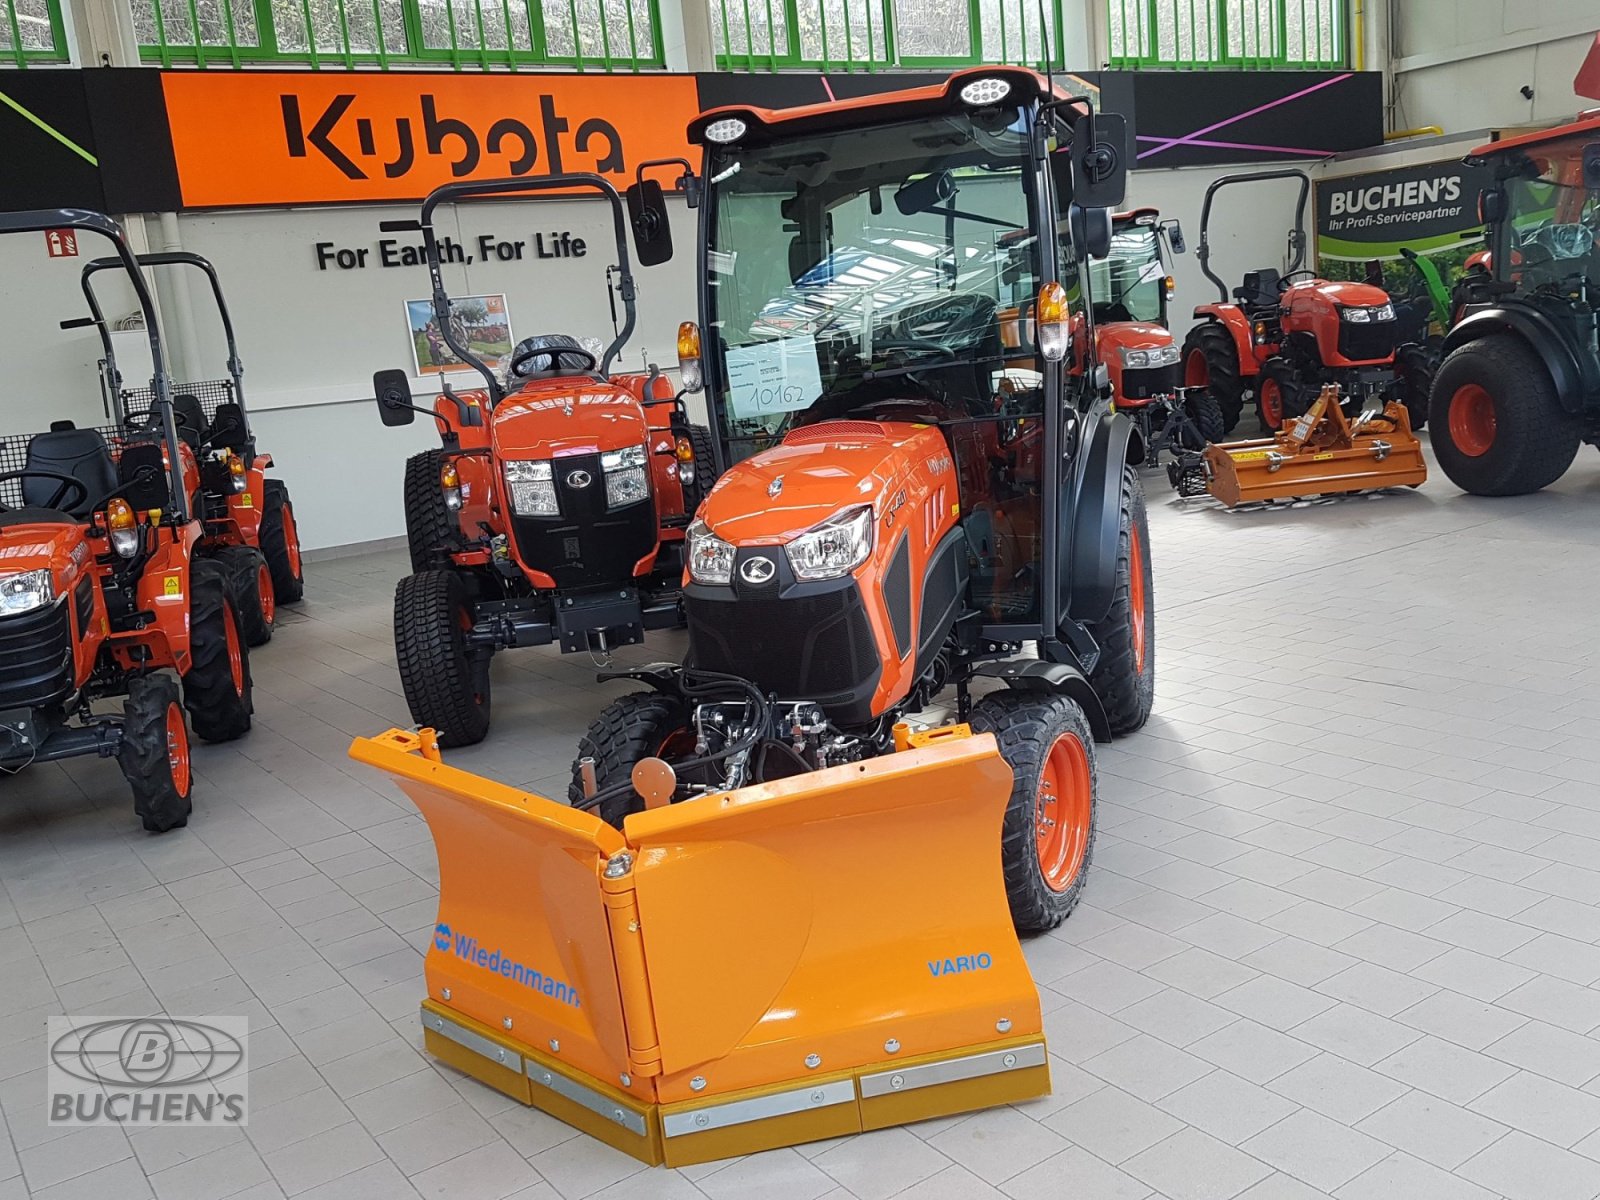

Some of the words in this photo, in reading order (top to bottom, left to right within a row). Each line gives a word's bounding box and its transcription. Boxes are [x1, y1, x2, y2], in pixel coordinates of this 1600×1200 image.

[280, 94, 625, 179] Kubota
[1330, 176, 1461, 216] BUCHEN'S
[1329, 219, 1344, 231] Ihr
[1346, 205, 1462, 229] Profi-Servicepartner
[315, 242, 369, 270] For
[379, 236, 473, 267] Earth,
[478, 235, 525, 262] For
[535, 232, 587, 258] Life
[750, 384, 804, 411] 10162
[455, 932, 581, 1008] Wiedenmann
[927, 953, 992, 977] VARIO
